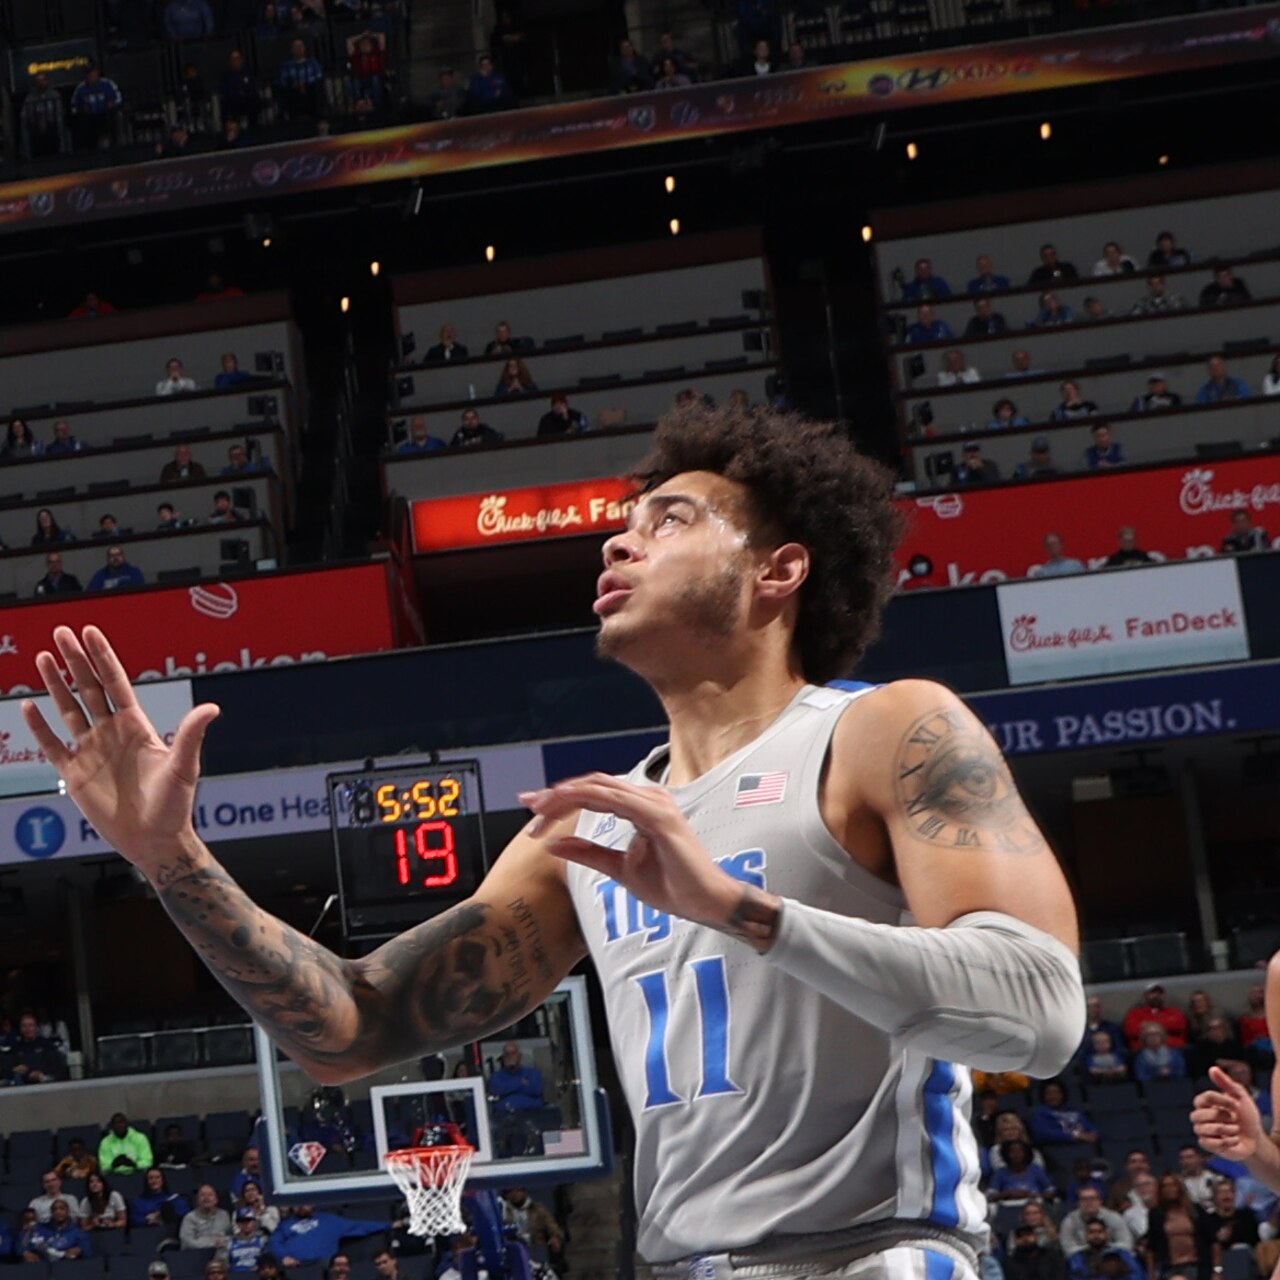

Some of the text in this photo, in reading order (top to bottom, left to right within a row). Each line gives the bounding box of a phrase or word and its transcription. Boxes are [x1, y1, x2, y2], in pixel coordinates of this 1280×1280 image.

[1125, 608, 1237, 639] FanDeck
[1055, 699, 1237, 748] PASSION.
[213, 800, 275, 827] One
[377, 777, 461, 823] 5:52
[394, 820, 458, 887] 19
[628, 954, 745, 1111] 11
